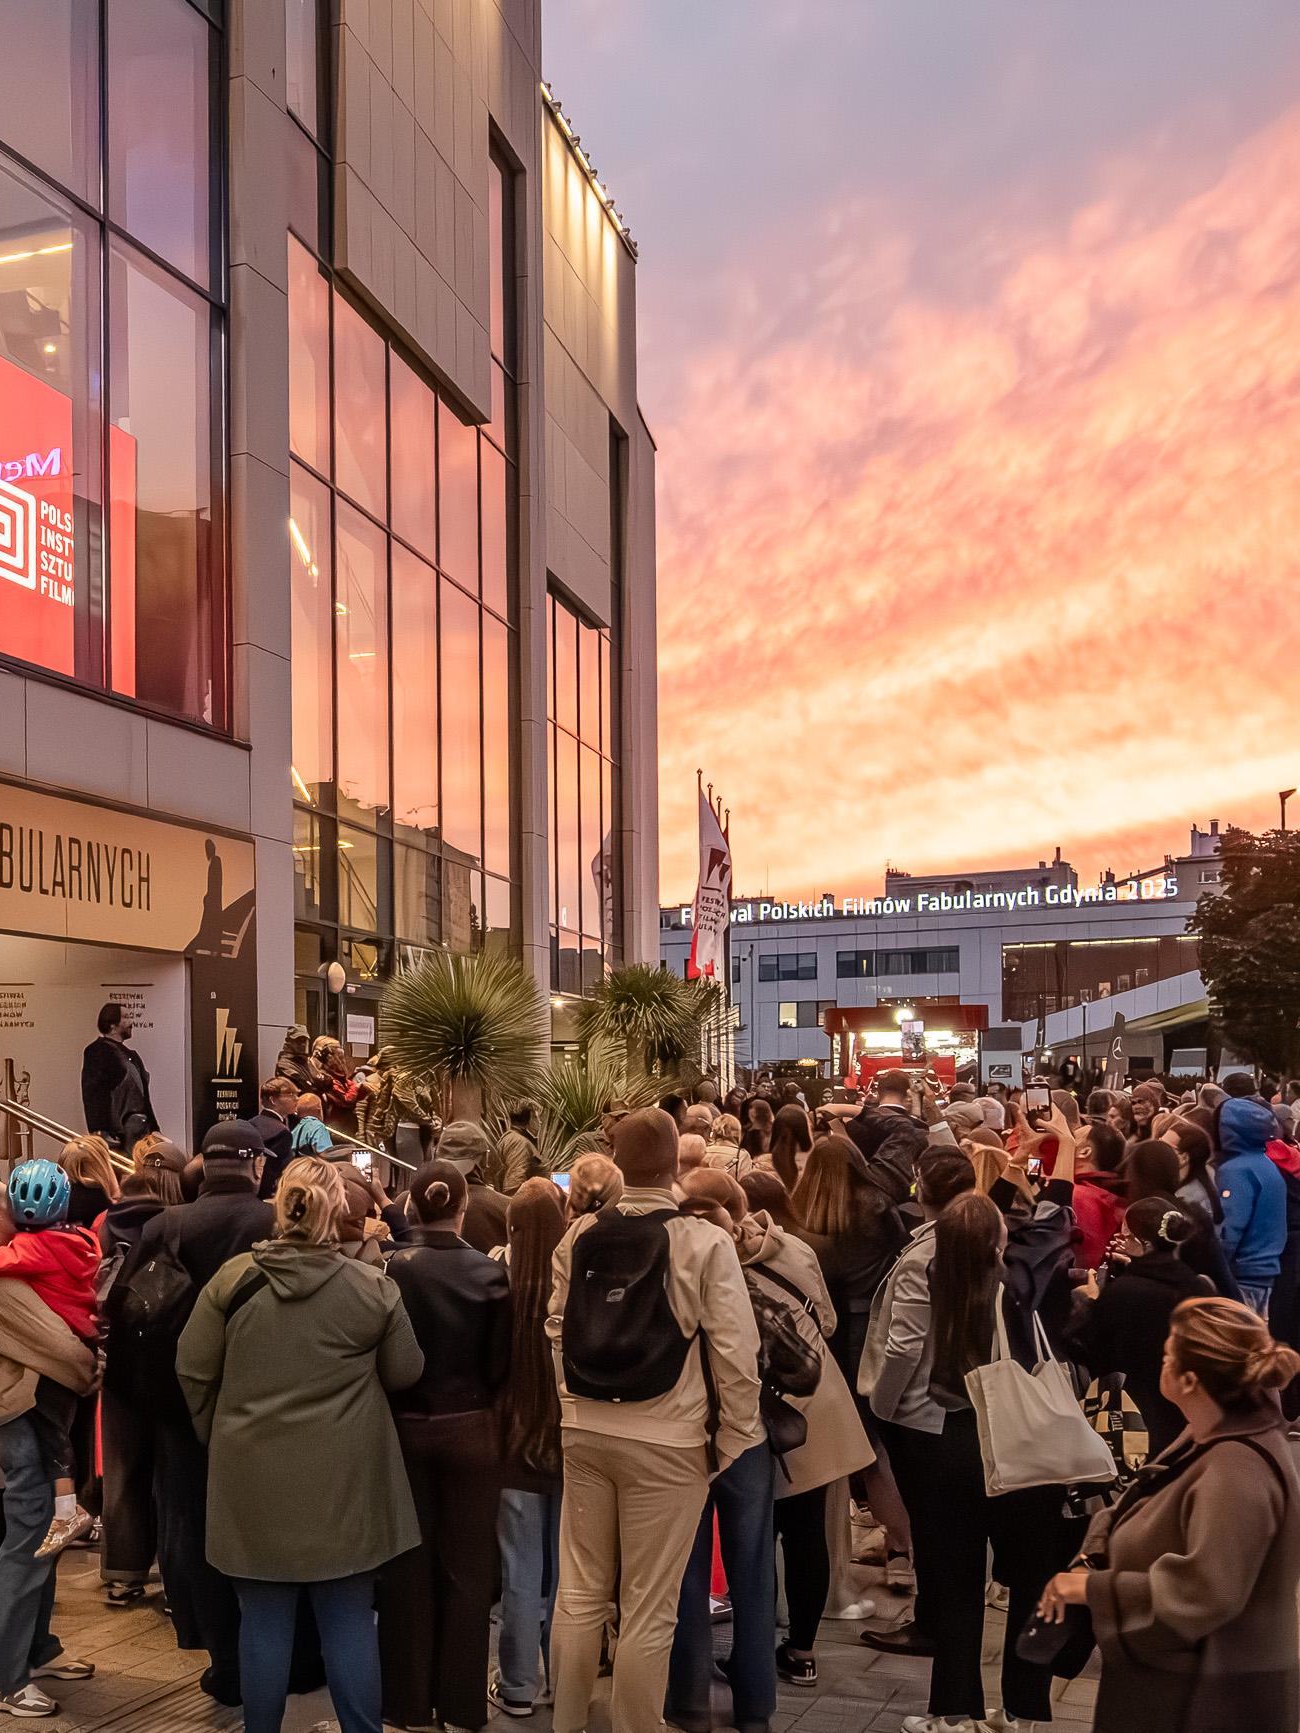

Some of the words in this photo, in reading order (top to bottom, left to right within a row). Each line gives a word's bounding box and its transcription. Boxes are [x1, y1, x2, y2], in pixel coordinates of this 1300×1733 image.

[40, 500, 74, 534] POLS
[681, 902, 753, 925] Fwal
[759, 899, 834, 921] Polskich
[842, 896, 911, 917] Filmów
[917, 885, 1039, 913] Fabularnych
[1045, 883, 1117, 908] Gdynia
[1126, 877, 1179, 900] 2025
